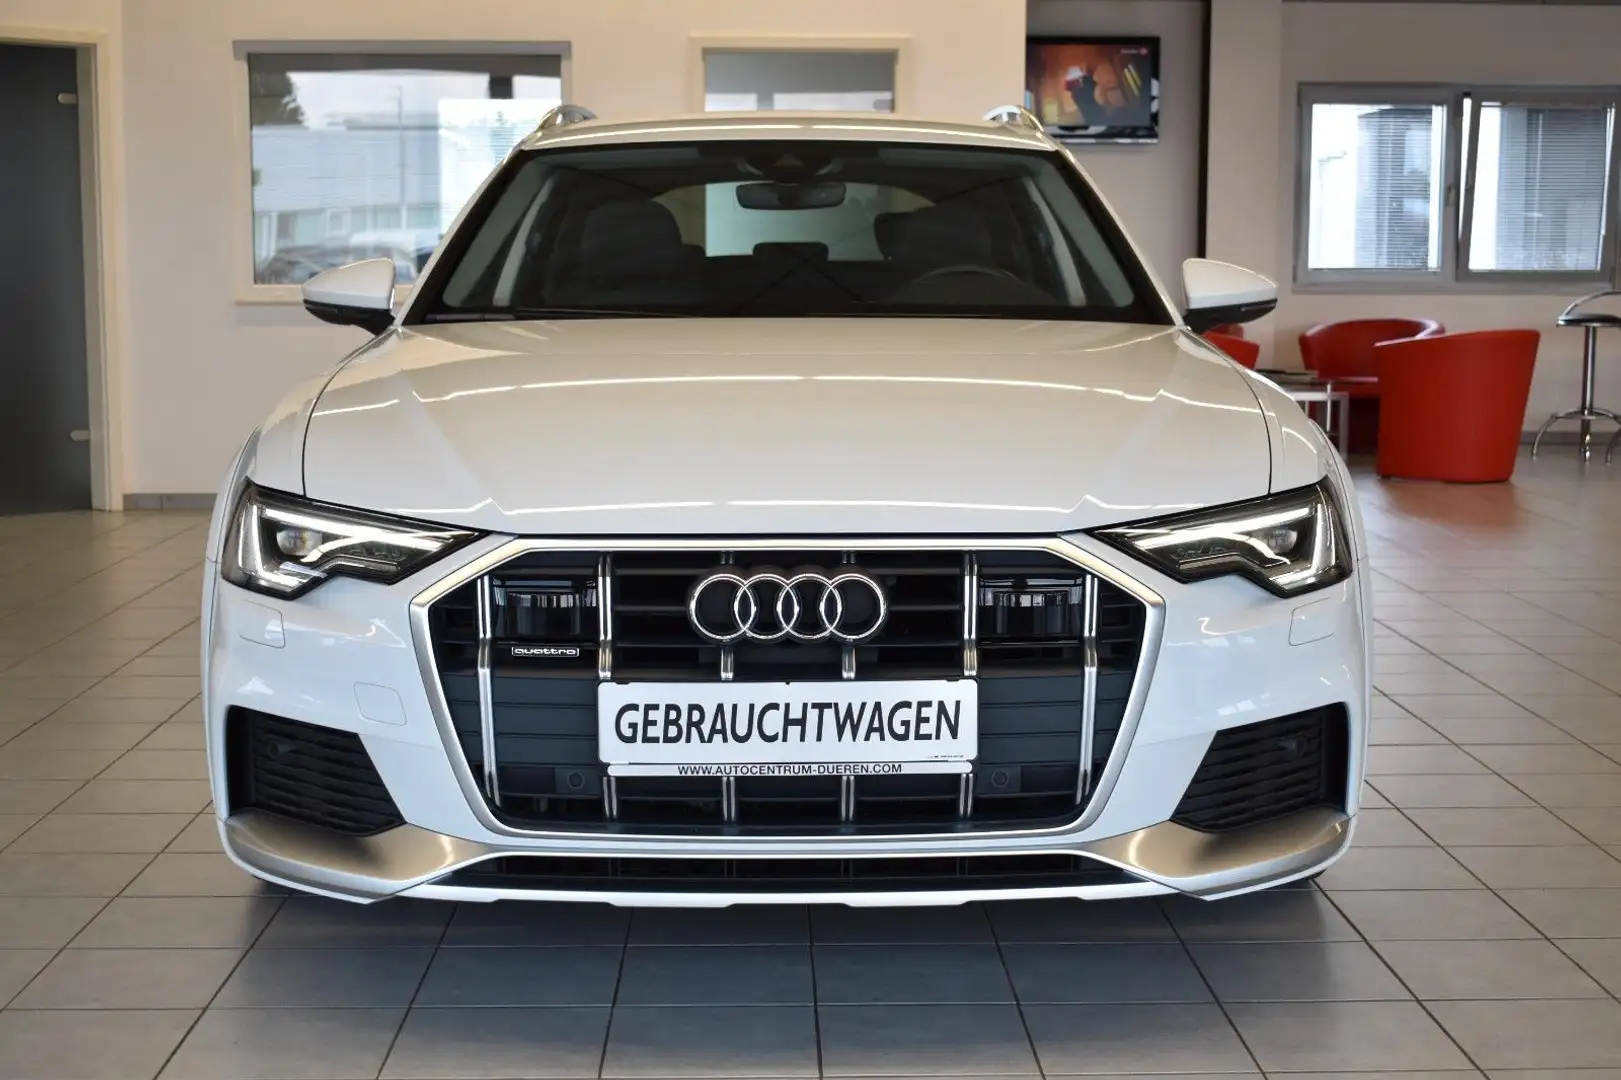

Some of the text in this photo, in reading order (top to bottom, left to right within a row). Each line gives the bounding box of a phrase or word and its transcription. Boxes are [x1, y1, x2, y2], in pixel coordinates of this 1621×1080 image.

[514, 648, 576, 656] quattro
[615, 700, 961, 744] GEBRAUCHTWAGEN
[677, 763, 903, 776] WWW.AUTOCENTRUM-DUEREN.COM
